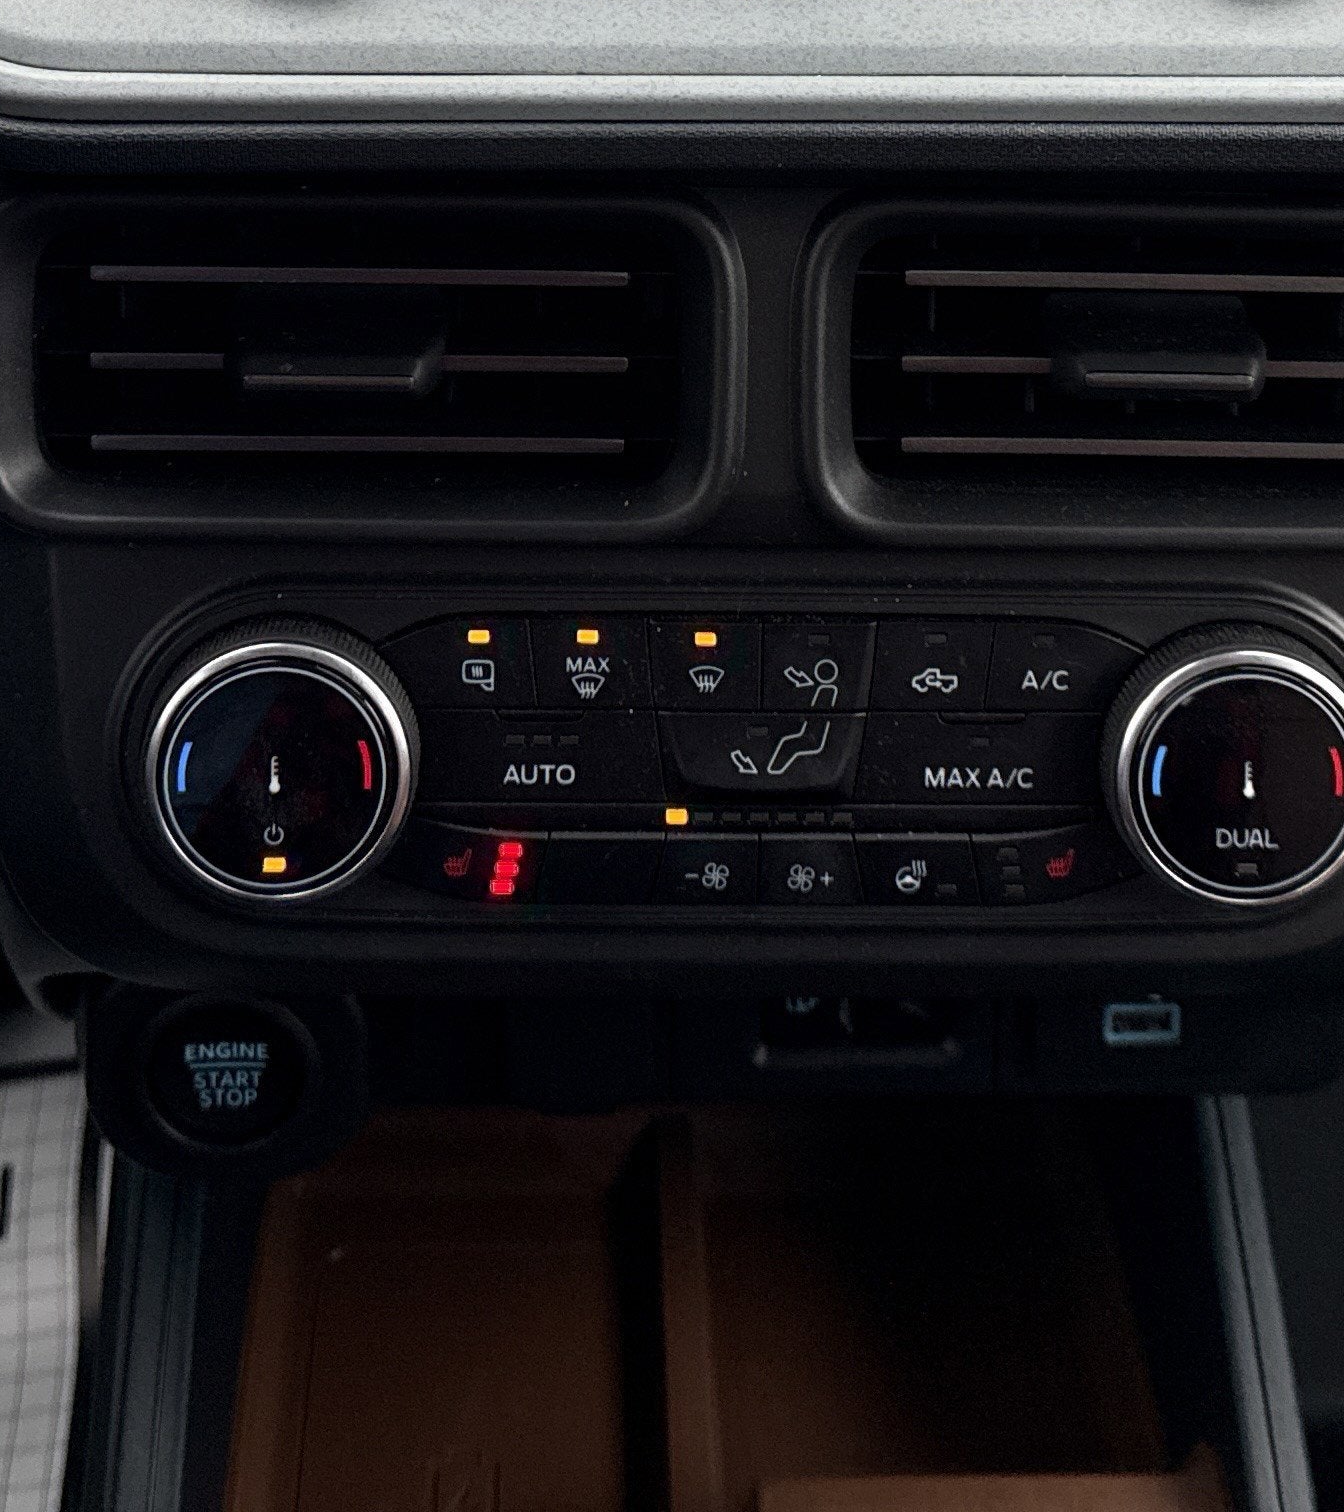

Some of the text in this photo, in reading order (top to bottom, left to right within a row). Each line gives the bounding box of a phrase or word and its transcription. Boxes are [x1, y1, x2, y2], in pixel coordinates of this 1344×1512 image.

[564, 656, 611, 674] MAX
[1021, 669, 1070, 692] A/C
[502, 764, 576, 786] AUTO
[923, 766, 1034, 790] MAX A/C
[1215, 827, 1280, 850] DUAL
[183, 1040, 270, 1063] ENGINE
[193, 1070, 263, 1089] START
[199, 1088, 258, 1111] STOP
